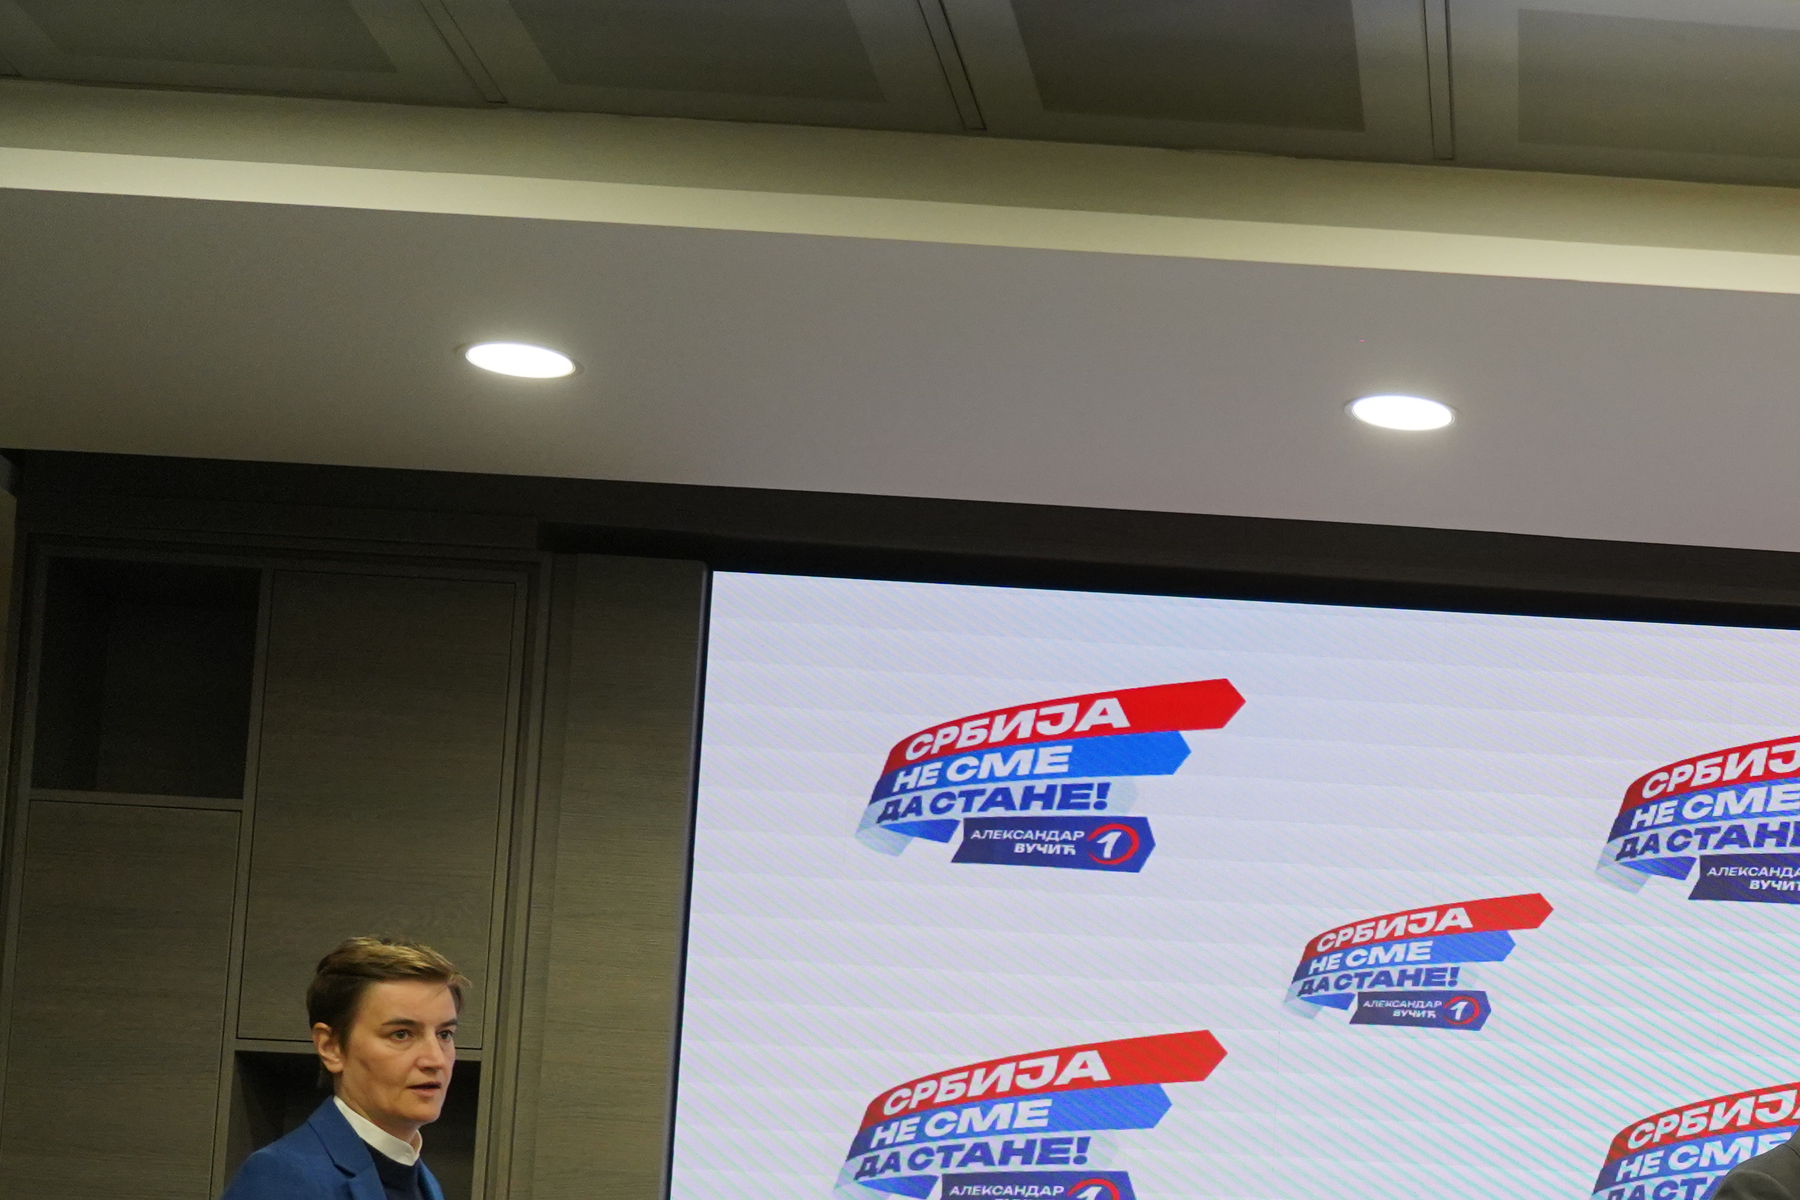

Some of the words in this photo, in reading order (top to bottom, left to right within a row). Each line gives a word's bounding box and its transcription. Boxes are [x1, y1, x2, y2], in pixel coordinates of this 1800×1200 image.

[905, 697, 1131, 761] СРБИЈА
[892, 762, 943, 793] НЕ
[946, 746, 1073, 782] СМЕ
[875, 795, 923, 824] ДА
[929, 782, 1111, 815] СТАНЕ!
[1630, 800, 1680, 831] НЕ
[970, 830, 1085, 842] АЛЕКСАНДАР
[1014, 843, 1076, 856] ВУЧИЋ
[1096, 831, 1122, 858] 1
[1615, 833, 1660, 861] ДА
[1316, 907, 1473, 952] СРБИЈА
[1308, 953, 1343, 975] НЕ
[1345, 941, 1433, 967] СМЕ
[1297, 977, 1329, 997] ДА
[1333, 966, 1460, 990] СТАНЕ!
[1450, 1001, 1468, 1020] 1
[883, 1049, 1111, 1116] СРБИЈА
[870, 1117, 920, 1149] НЕ
[924, 1099, 1053, 1138] СМЕ
[854, 1151, 901, 1181] ДА
[907, 1136, 1091, 1171] СТАНЕ!
[1616, 1150, 1663, 1182] НЕ
[949, 1186, 1065, 1198] АЛЕКСАНДАР
